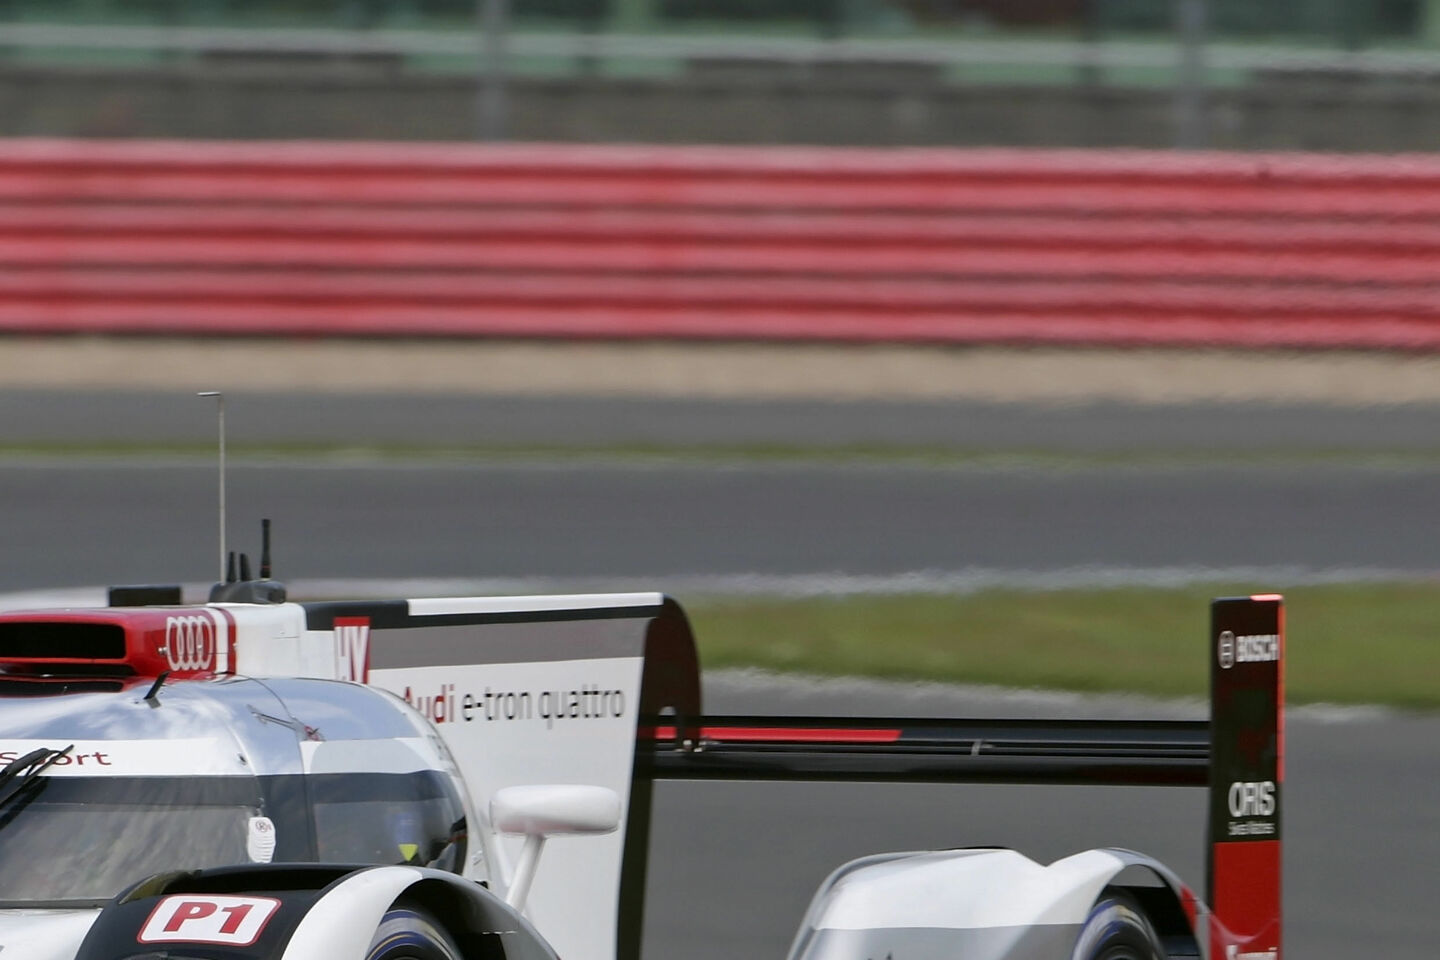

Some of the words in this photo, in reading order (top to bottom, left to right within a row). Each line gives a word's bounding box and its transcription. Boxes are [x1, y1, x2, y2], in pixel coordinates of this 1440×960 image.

[462, 687, 533, 721] e-tron
[538, 684, 626, 730] quattro
[1228, 781, 1275, 817] ORIS
[162, 901, 255, 934] P1
